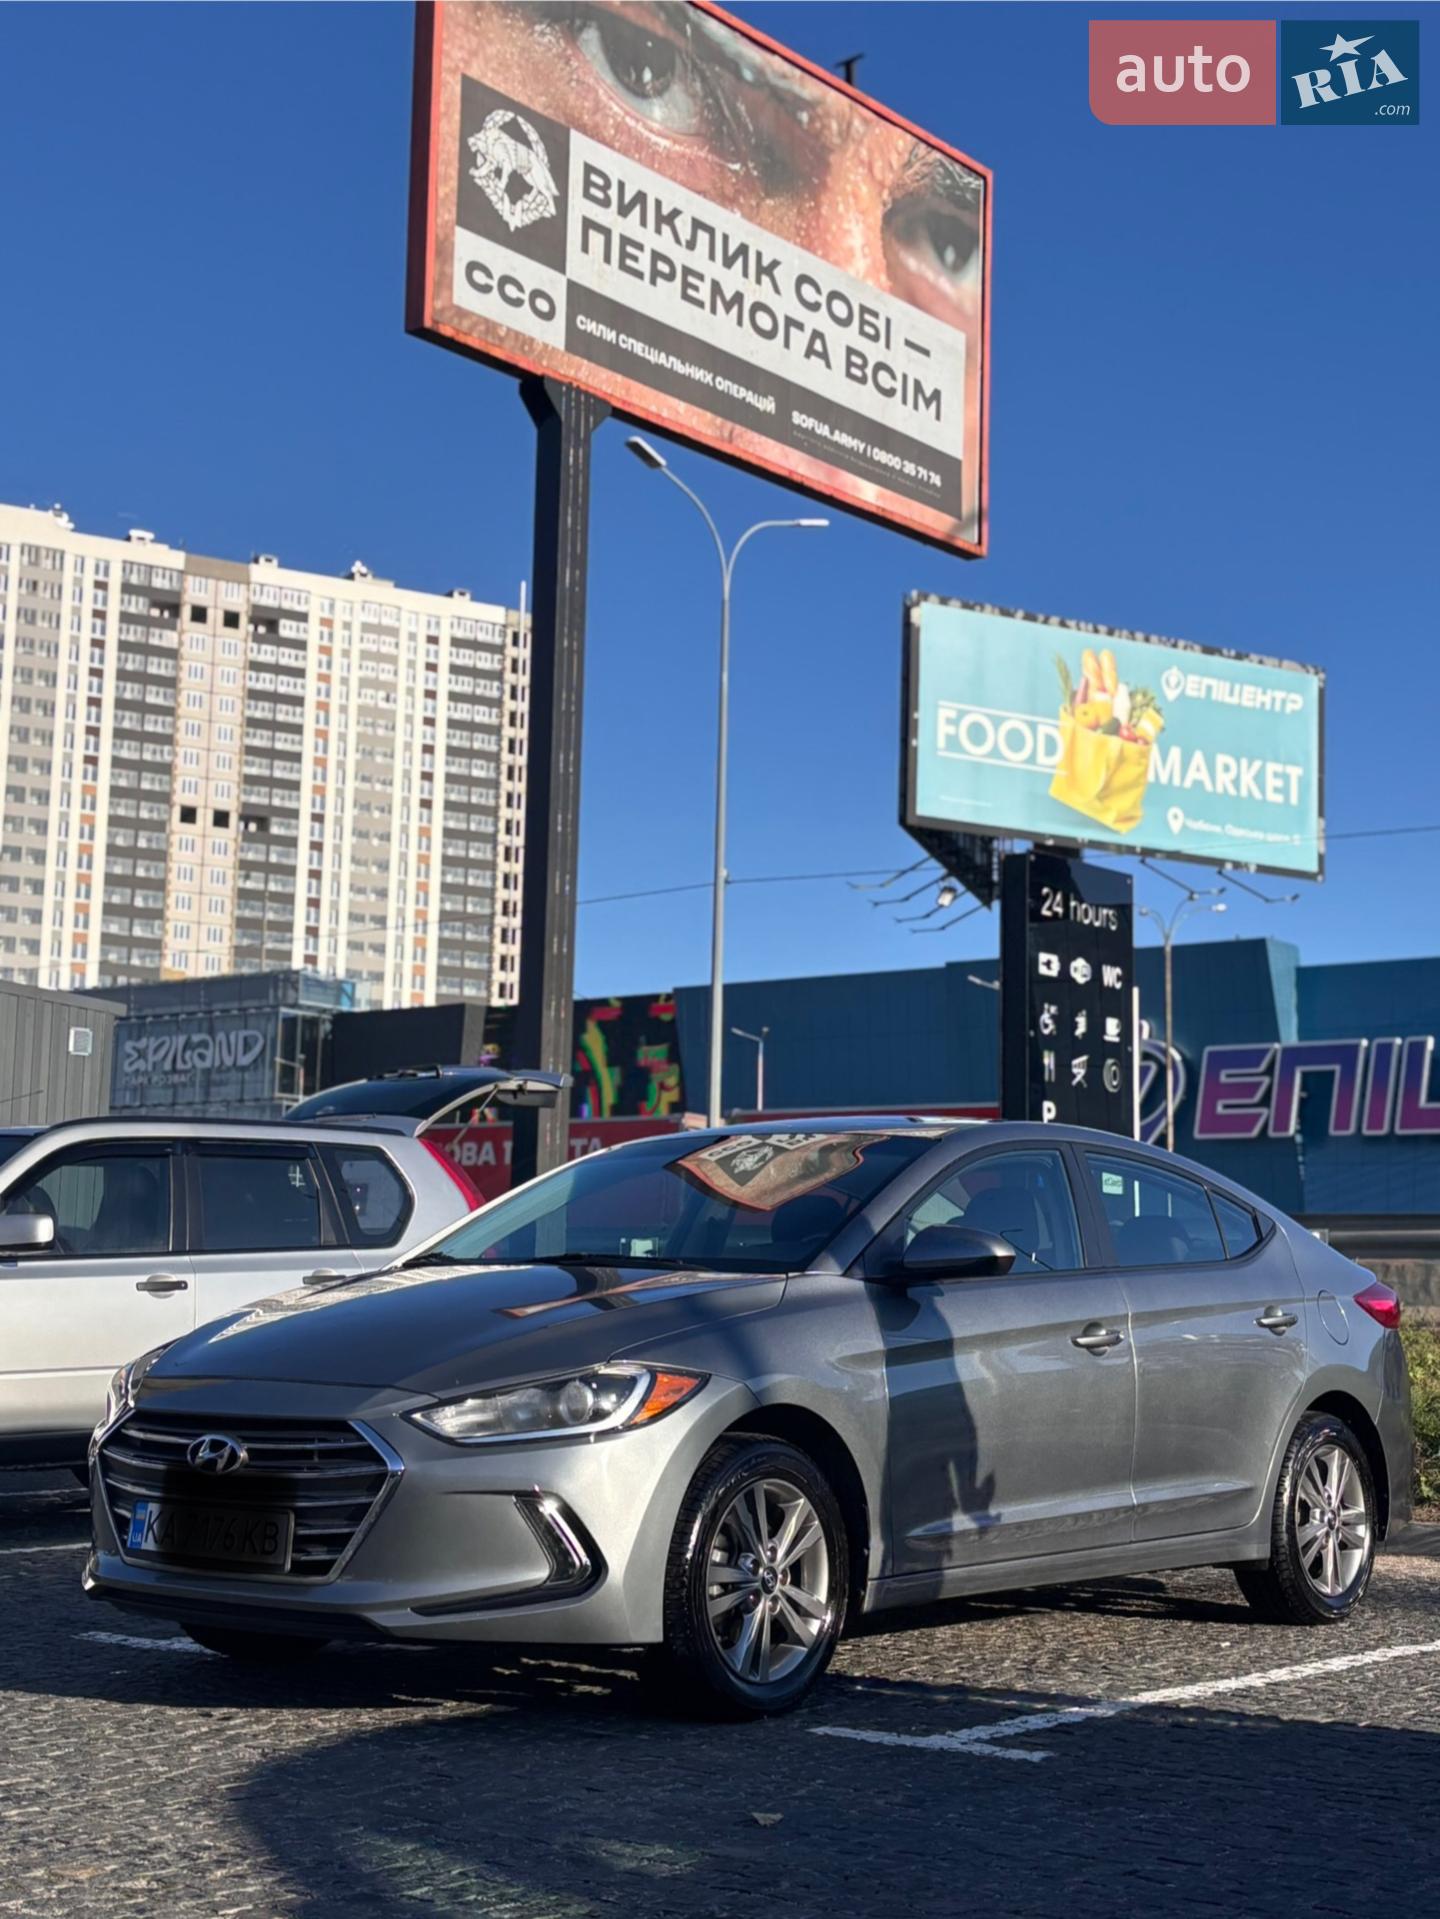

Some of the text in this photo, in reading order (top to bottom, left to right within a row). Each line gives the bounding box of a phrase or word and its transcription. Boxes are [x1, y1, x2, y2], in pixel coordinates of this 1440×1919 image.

[582, 160, 782, 297] ВИКЛИК
[795, 273, 892, 350] СОБІ
[465, 260, 557, 322] ССО
[580, 214, 942, 422] ПЕРЕМОГА ВСІМ
[576, 314, 776, 414] СИЛИ СПЕЦІАЛЬНИХ ОПЕРАЦІЙ
[791, 410, 866, 454] SOFUA.ARMY
[872, 447, 902, 471] 0800
[902, 460, 917, 477] 35
[1185, 674, 1304, 714] ЕПІЦЕНТР
[937, 707, 1066, 767] FOOD
[1147, 742, 1304, 806] MARKET
[1041, 887, 1119, 931] 24 hours
[1102, 964, 1123, 989] WC
